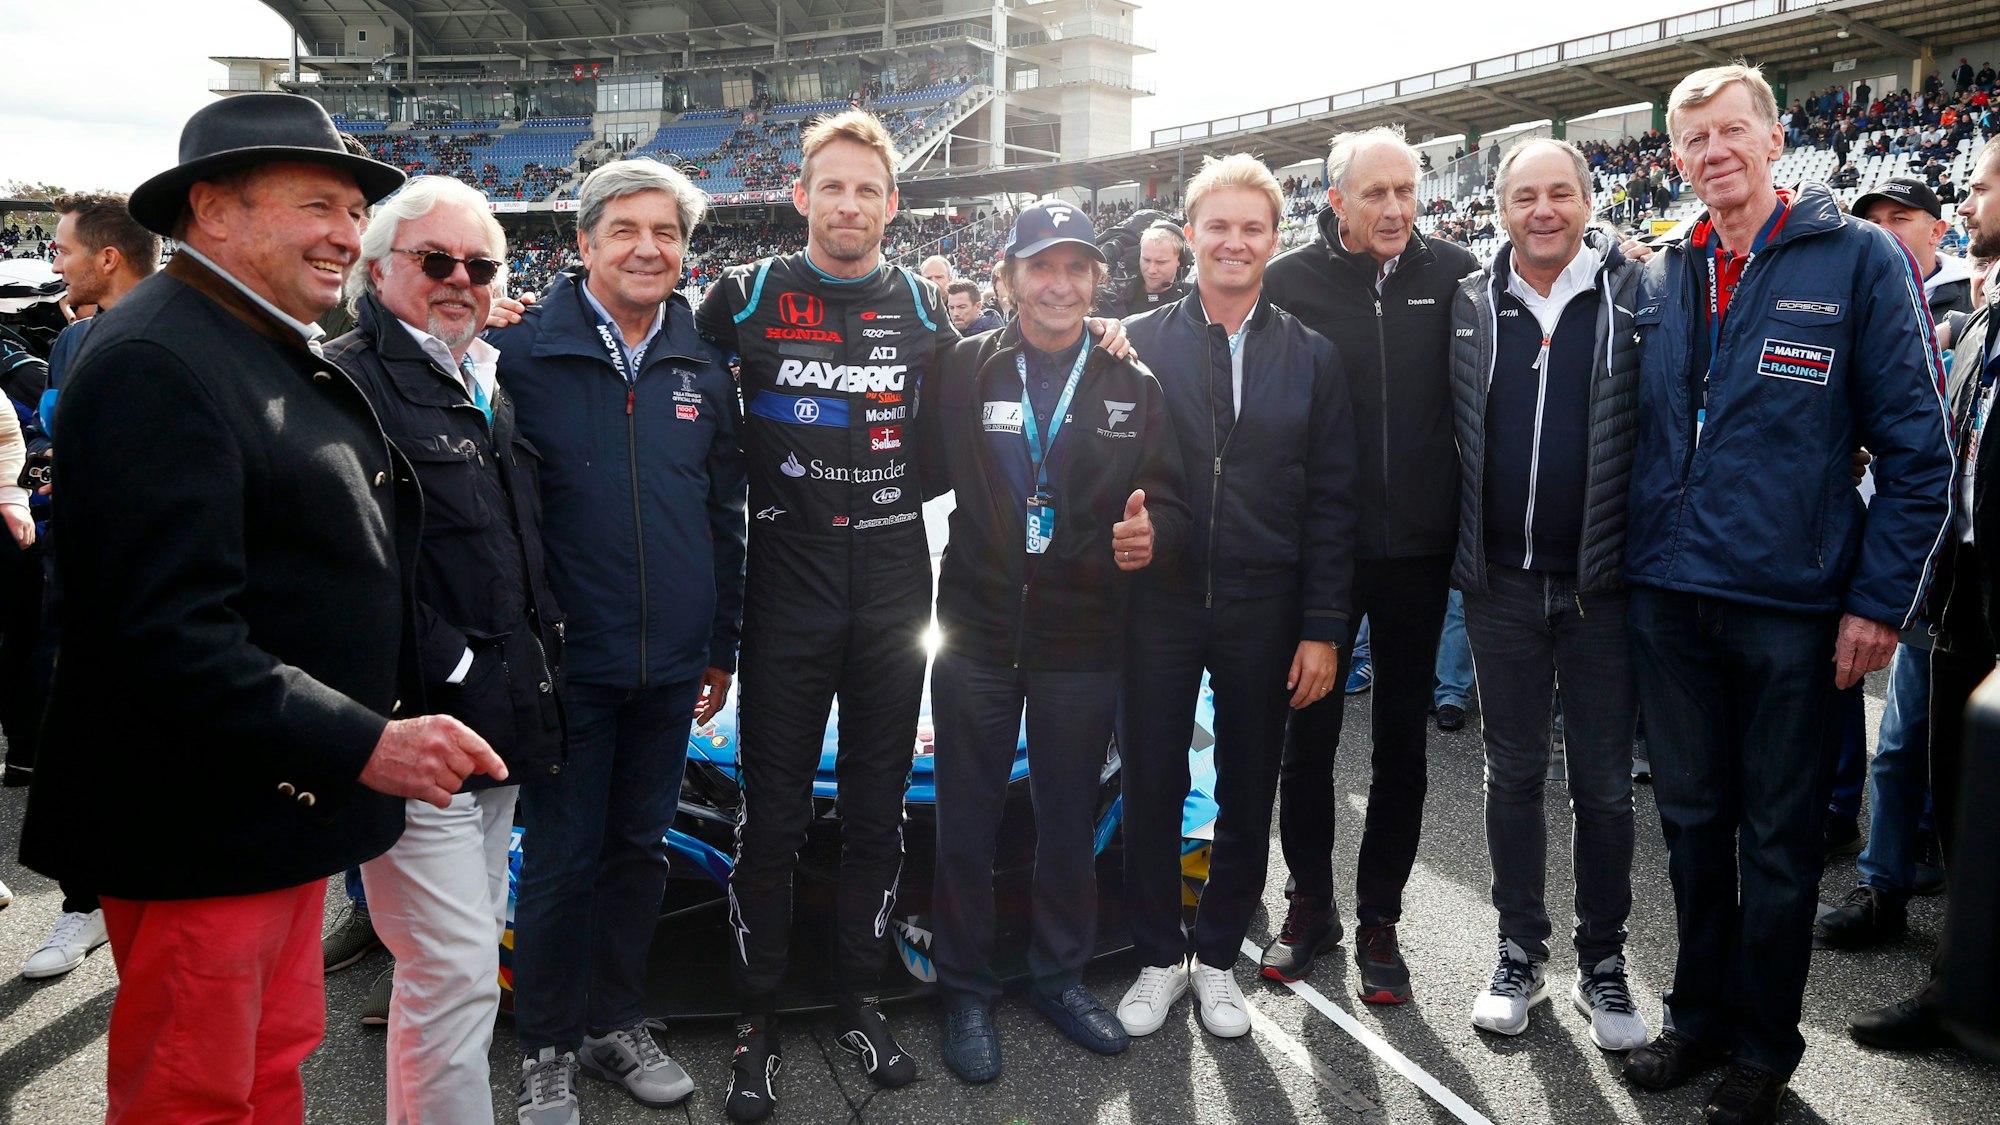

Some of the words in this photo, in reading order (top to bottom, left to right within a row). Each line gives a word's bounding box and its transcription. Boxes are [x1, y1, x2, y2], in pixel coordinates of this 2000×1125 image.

[1707, 257, 1718, 313] DTM.COM
[1407, 298, 1436, 306] DMSB
[1779, 301, 1838, 313] PORSCHE
[1499, 308, 1520, 318] DTM
[766, 328, 844, 343] HONDA
[1456, 328, 1475, 338] DTM
[1774, 344, 1822, 362] MARTINI
[776, 360, 907, 392] RAYBRIG
[1066, 370, 1081, 396] DTM
[1076, 348, 1089, 373] 2019
[1770, 361, 1820, 379] RACING
[796, 402, 818, 419] ZF
[865, 407, 898, 422] Mobil
[810, 458, 907, 485] Santander
[875, 489, 899, 501] Arai
